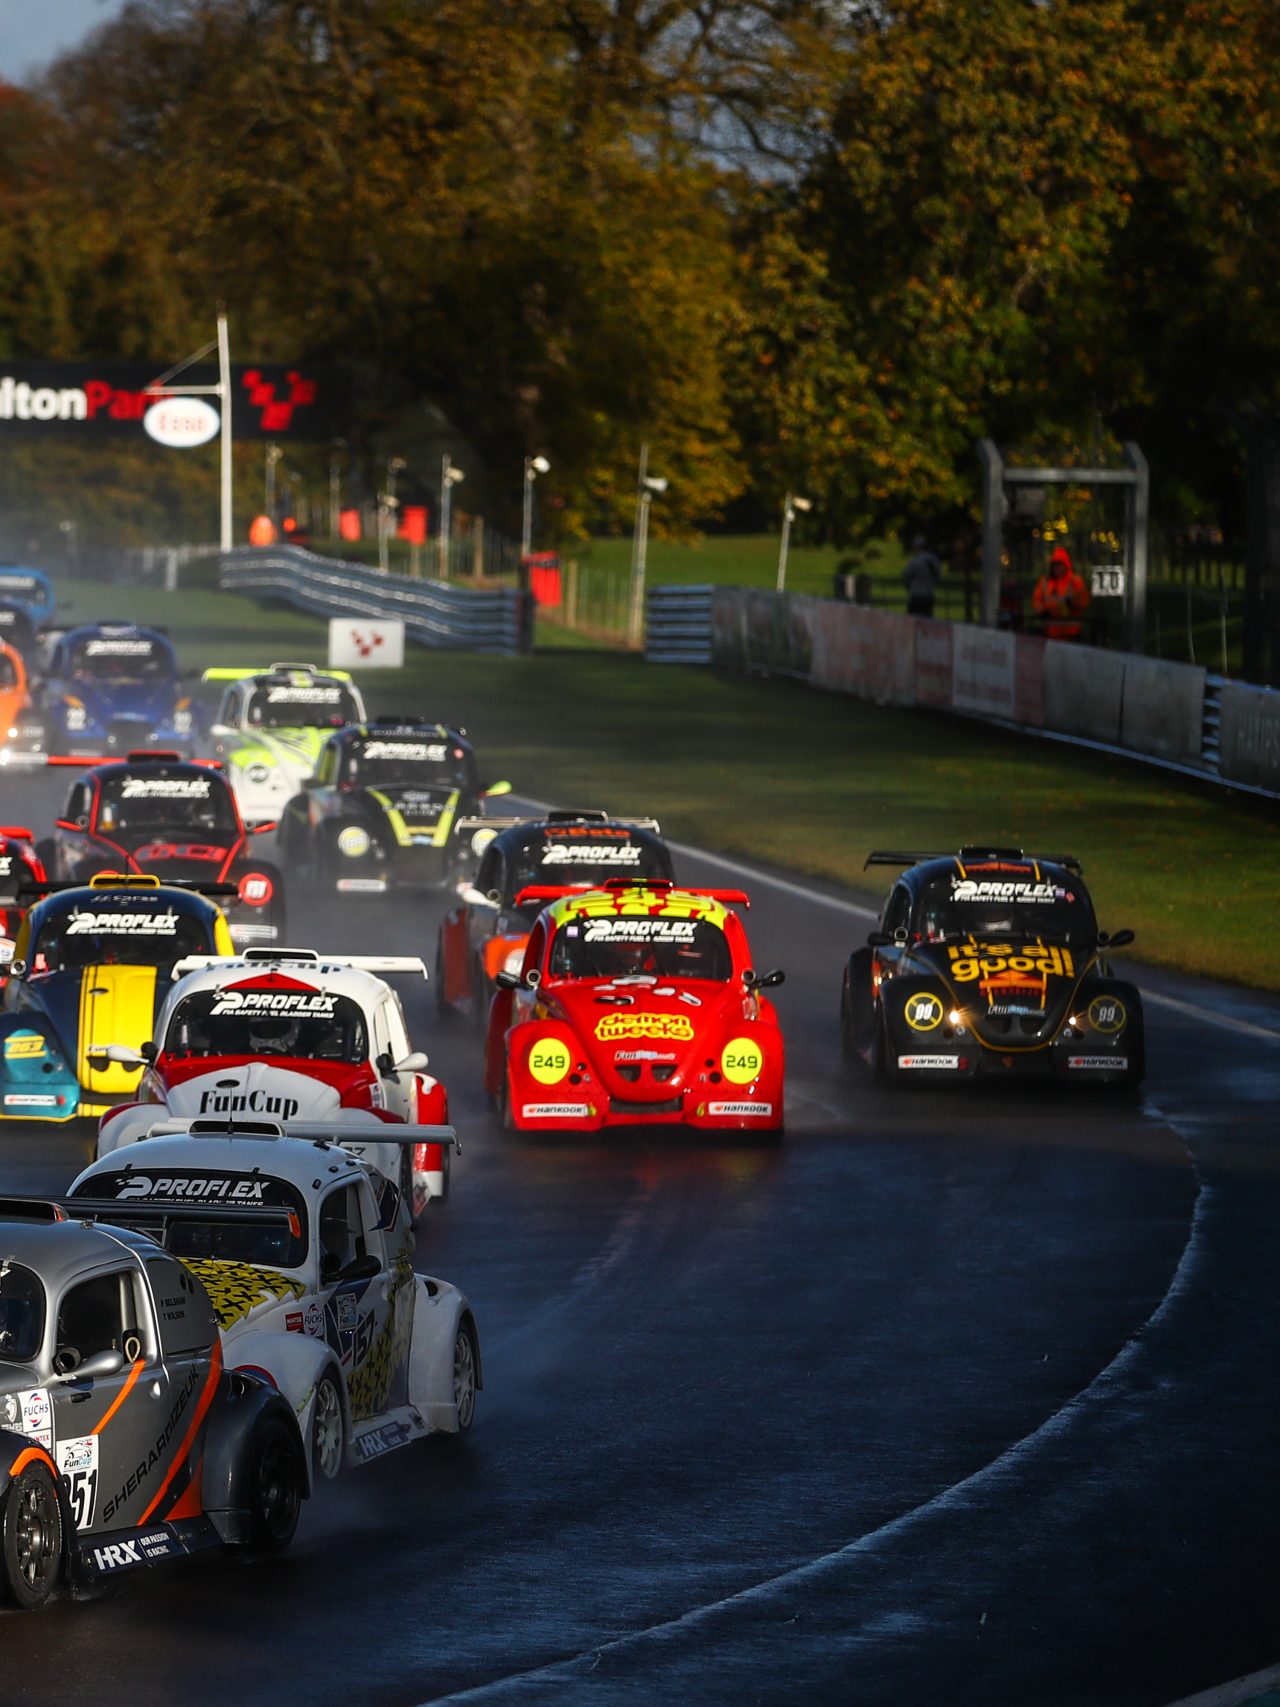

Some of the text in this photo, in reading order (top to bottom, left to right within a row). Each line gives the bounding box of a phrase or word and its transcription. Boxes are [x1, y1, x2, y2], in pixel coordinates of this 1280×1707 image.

[568, 847, 642, 859] PROFLEX
[977, 882, 1057, 896] PROFLEX
[95, 914, 180, 928] PROFLEX
[612, 921, 698, 936] PROFLEX
[951, 954, 1075, 982] good!
[239, 994, 339, 1011] PROFLEX
[534, 1055, 565, 1069] 249
[725, 1055, 758, 1069] 249
[199, 1089, 299, 1120] FunCup
[151, 1179, 269, 1198] PROFLEX
[305, 1313, 323, 1325] FUCHS
[24, 1403, 49, 1417] FUCHS
[63, 1456, 93, 1469] FunCup
[94, 1540, 142, 1570] HRX
